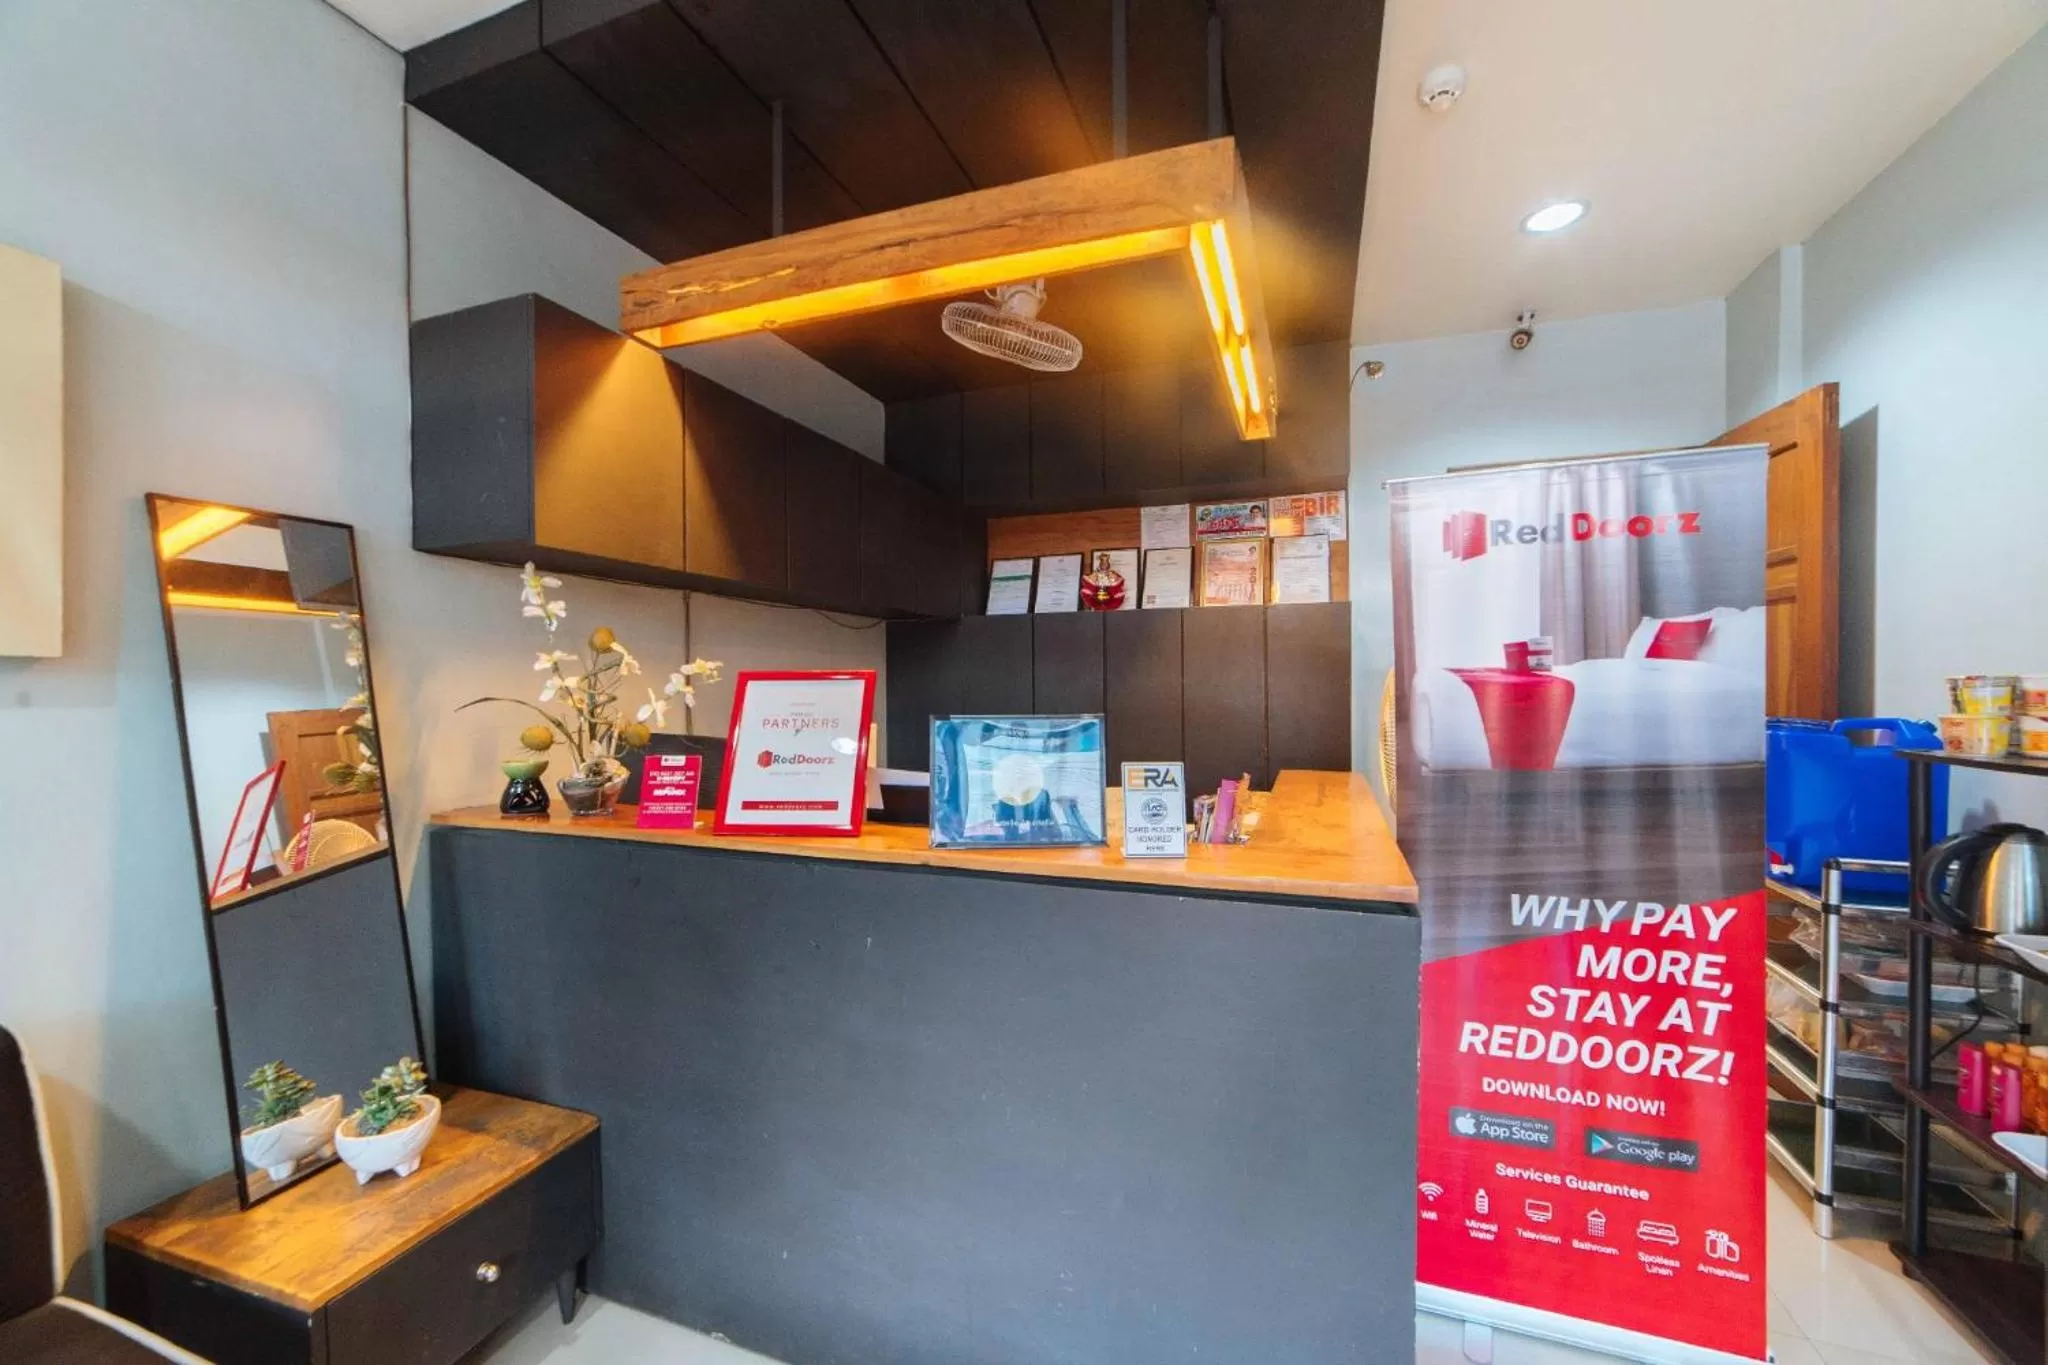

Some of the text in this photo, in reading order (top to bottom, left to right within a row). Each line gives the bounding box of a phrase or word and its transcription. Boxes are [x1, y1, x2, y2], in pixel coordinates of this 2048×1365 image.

[762, 717, 840, 730] PARTNERS
[772, 753, 835, 766] RedDoorz
[1127, 767, 1179, 789] ERA
[1510, 893, 1738, 942] WHY PAY
[1576, 944, 1735, 998] MORE,
[1526, 984, 1733, 1037] STAY AT
[1459, 1021, 1736, 1087] REDDOORZ!
[1481, 1077, 1666, 1117] DOWNLOAD NOW!
[1480, 1122, 1549, 1144] App Store
[1534, 1123, 1549, 1131] the
[1617, 1141, 1696, 1166] Google play
[1495, 1162, 1650, 1201] Services Guarantee
[1464, 1218, 1498, 1233] Mineral
[1468, 1228, 1495, 1241] Water
[1516, 1227, 1562, 1245] Television
[1572, 1238, 1620, 1256] Bathroom
[1637, 1251, 1681, 1269] Spotless
[1645, 1263, 1674, 1278] Linen
[1697, 1262, 1751, 1283] Amenities
